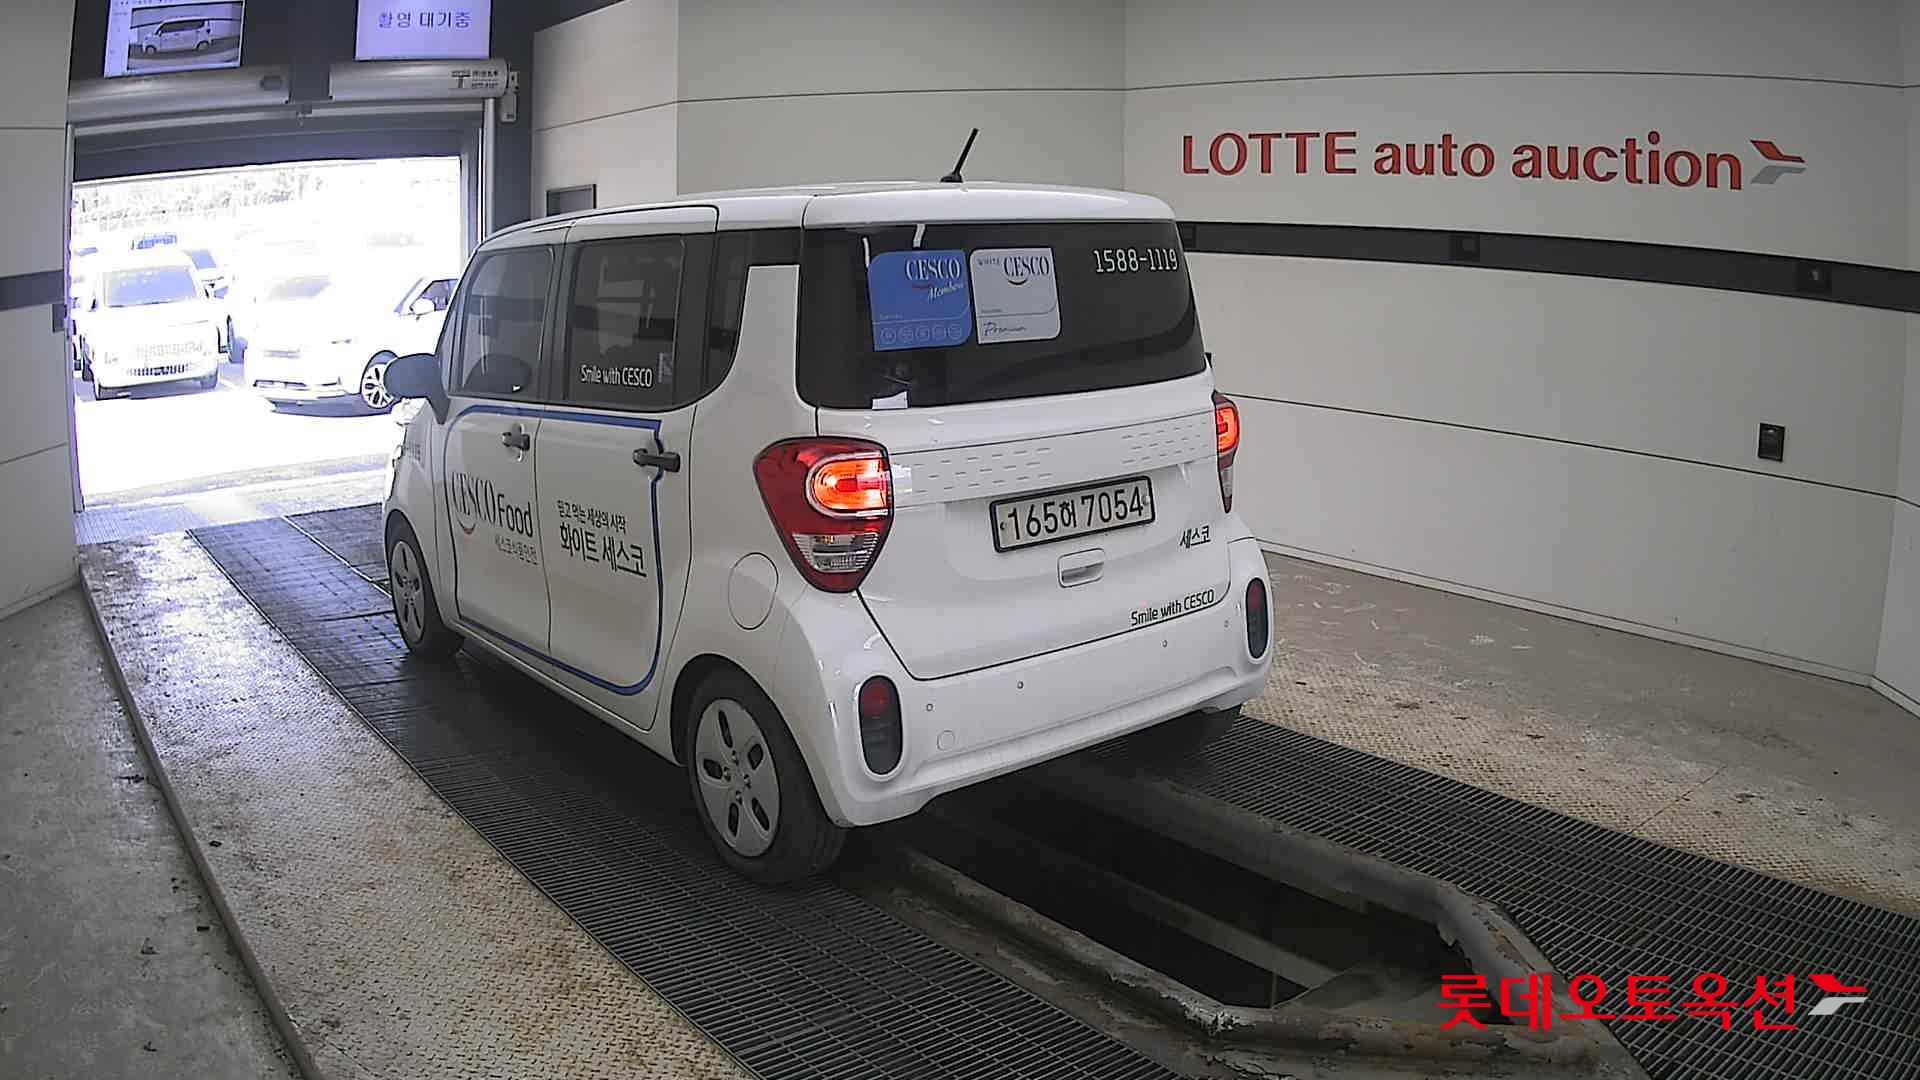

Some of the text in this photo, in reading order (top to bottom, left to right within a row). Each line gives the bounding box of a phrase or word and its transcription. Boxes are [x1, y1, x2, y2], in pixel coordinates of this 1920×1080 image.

[419, 11, 471, 29] 대기중
[1182, 131, 1743, 191] LOTTE auto auction
[905, 257, 960, 281] CESCO
[1003, 255, 1050, 277] CESCO
[1093, 248, 1178, 273] 1588-1119
[580, 364, 653, 387] Smile with CESCO
[451, 472, 534, 538] CESCO Food
[1008, 486, 1144, 541] 165허 7054
[610, 512, 627, 535] 시작
[1179, 525, 1212, 549] 세스코
[559, 521, 647, 578] 화이트 세스코
[1131, 588, 1215, 626] Smile with CESCO
